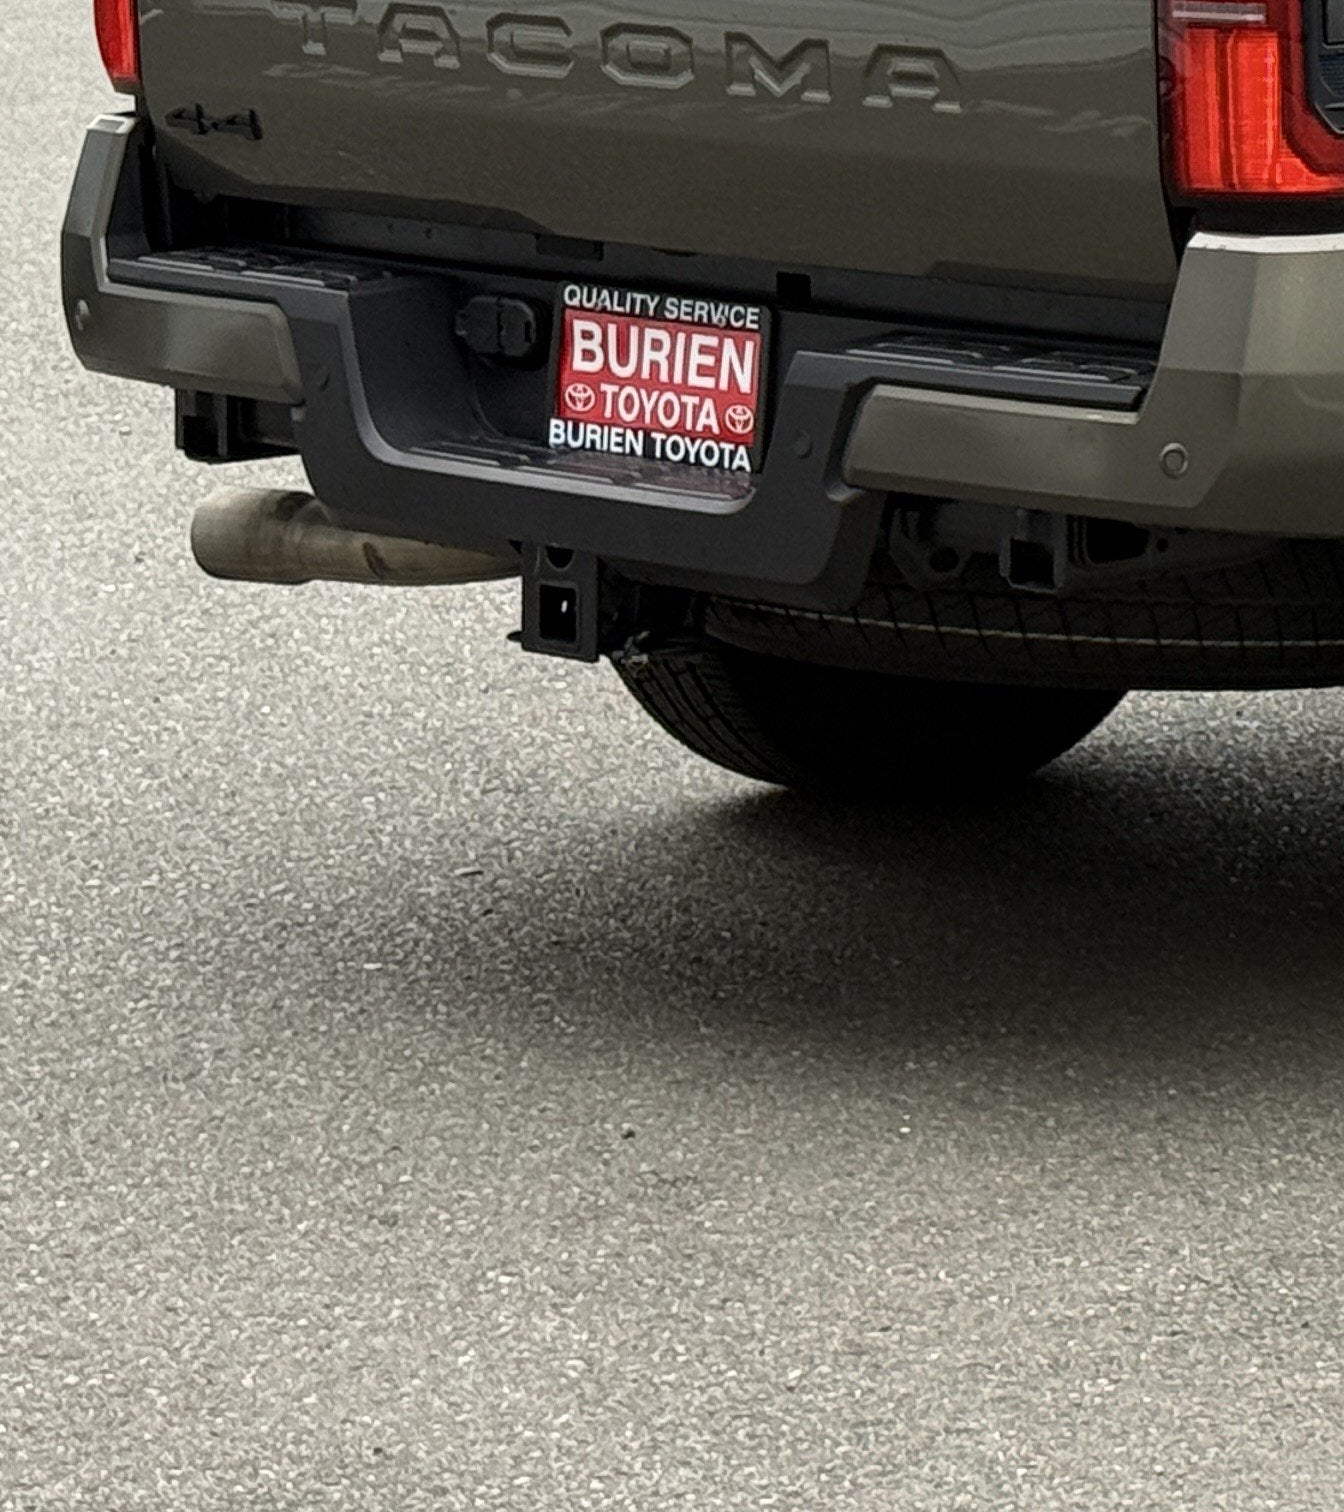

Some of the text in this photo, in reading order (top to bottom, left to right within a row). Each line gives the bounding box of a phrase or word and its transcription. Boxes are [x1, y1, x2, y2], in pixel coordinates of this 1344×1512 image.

[563, 284, 760, 329] QUALITY SERVICE
[572, 318, 755, 394] BURIEN
[600, 383, 721, 435] TOYOTA
[550, 418, 751, 472] BURIEN TOYOTA
